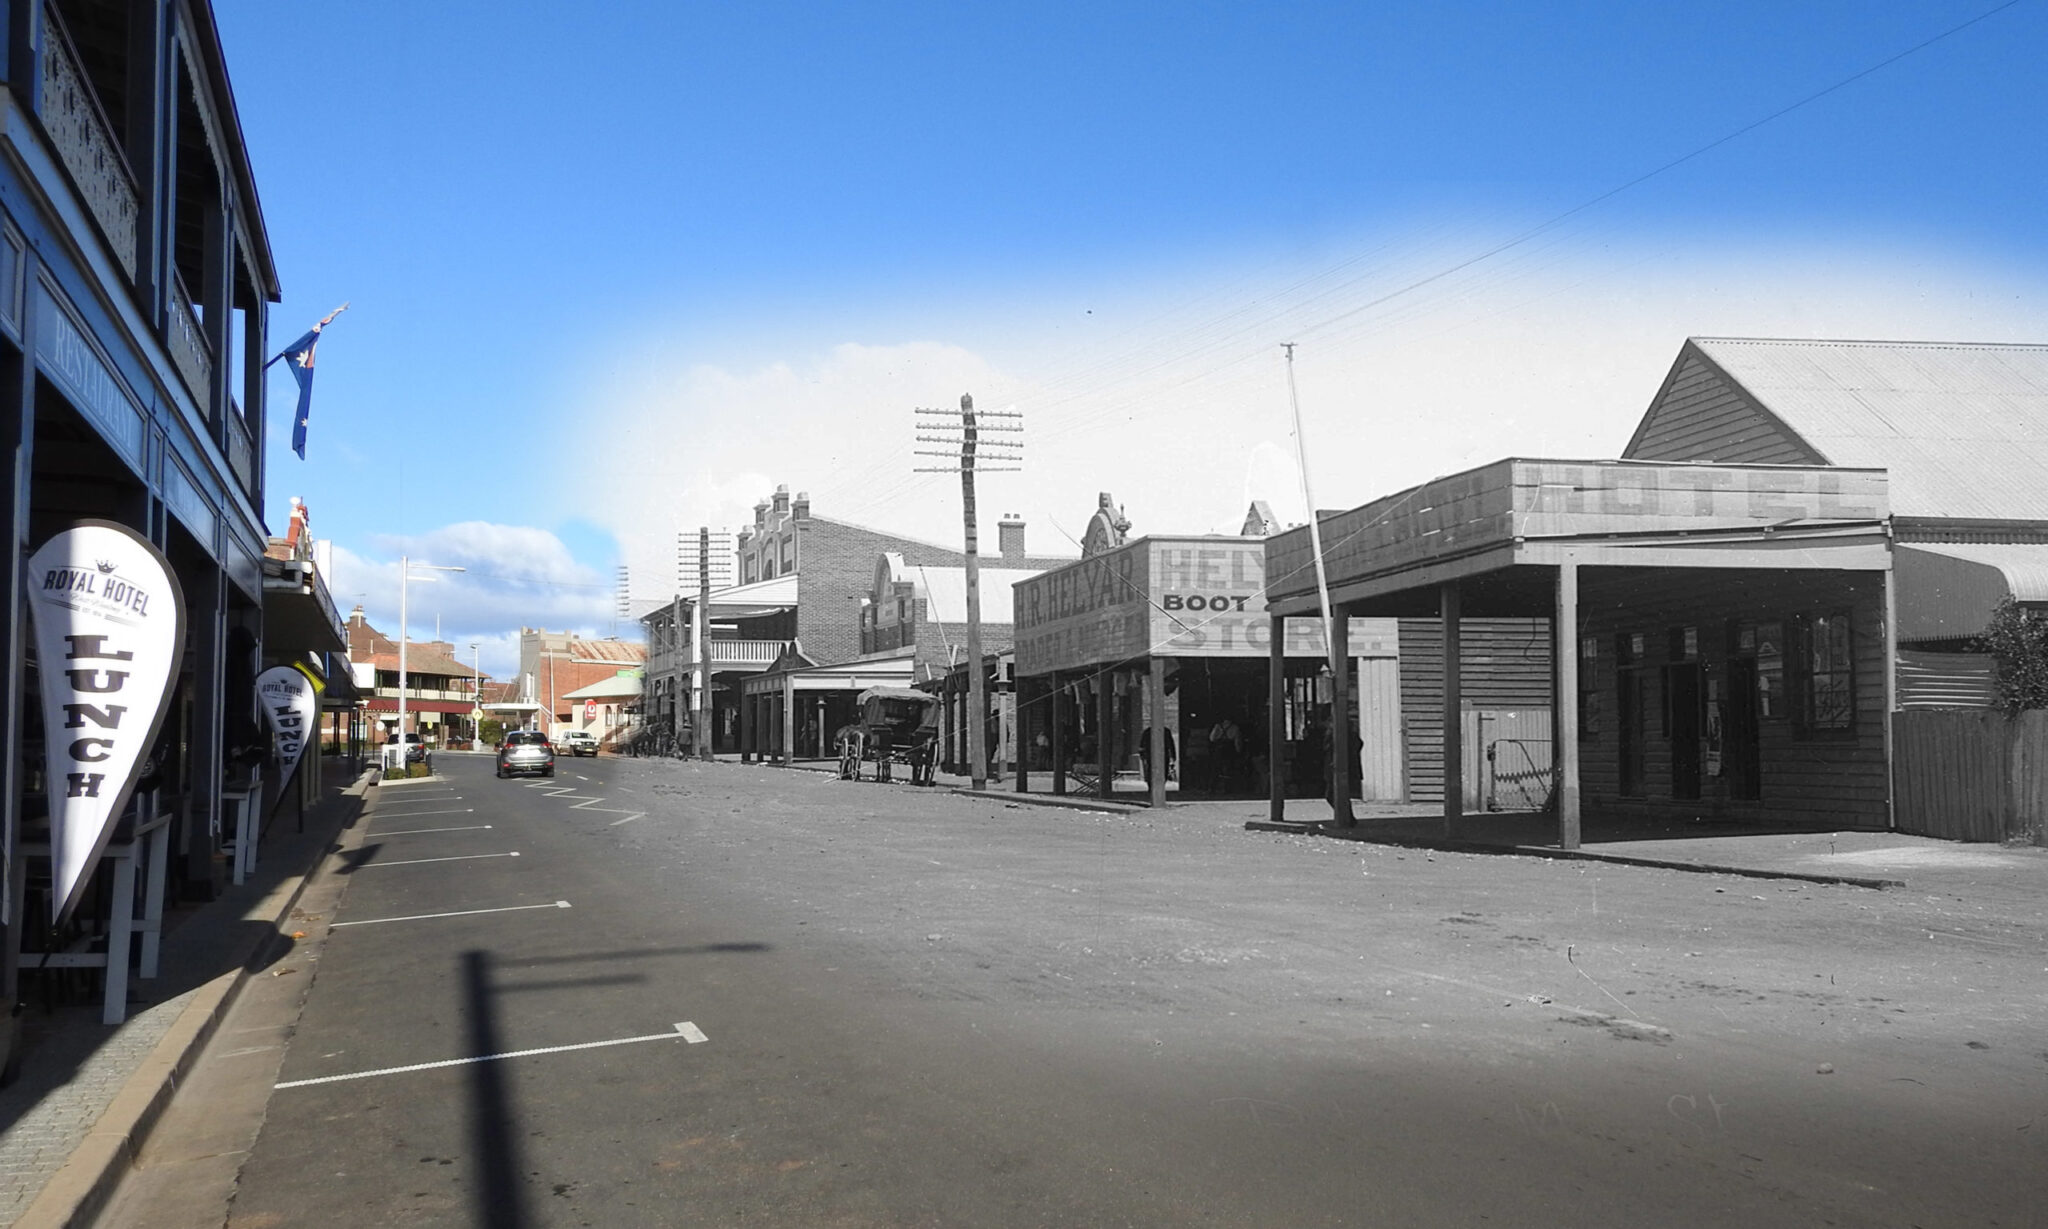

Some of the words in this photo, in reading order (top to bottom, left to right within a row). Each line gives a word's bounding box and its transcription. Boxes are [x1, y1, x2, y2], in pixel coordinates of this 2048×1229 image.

[54, 311, 133, 449] RESTAURANT
[1524, 466, 1876, 518] HOTEL
[42, 569, 95, 594] ROYAL
[102, 578, 149, 618] HOTEL
[1163, 595, 1250, 612] BOOT
[62, 634, 134, 798] LUNCH
[273, 705, 303, 765] LUNCH
